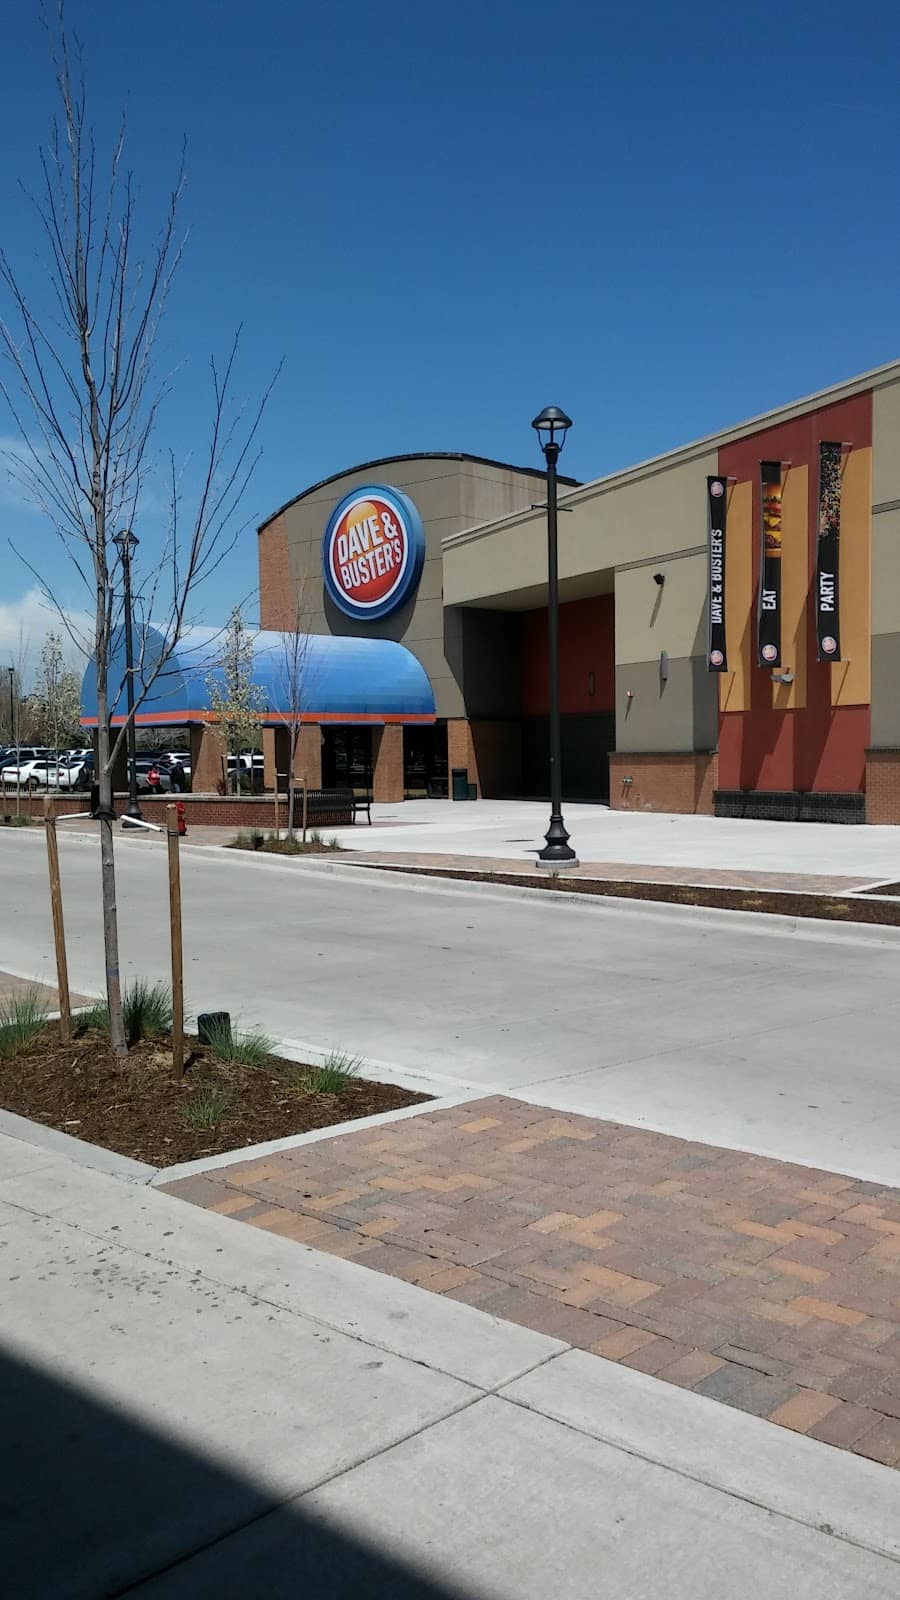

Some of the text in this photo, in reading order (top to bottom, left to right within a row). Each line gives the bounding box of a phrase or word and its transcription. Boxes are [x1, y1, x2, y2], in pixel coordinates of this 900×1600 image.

[338, 512, 402, 590] DAVE & BUSTER'S
[711, 529, 723, 625] DAVE & BUSTER'S
[762, 588, 777, 611] EAT
[820, 571, 835, 612] PARTY
